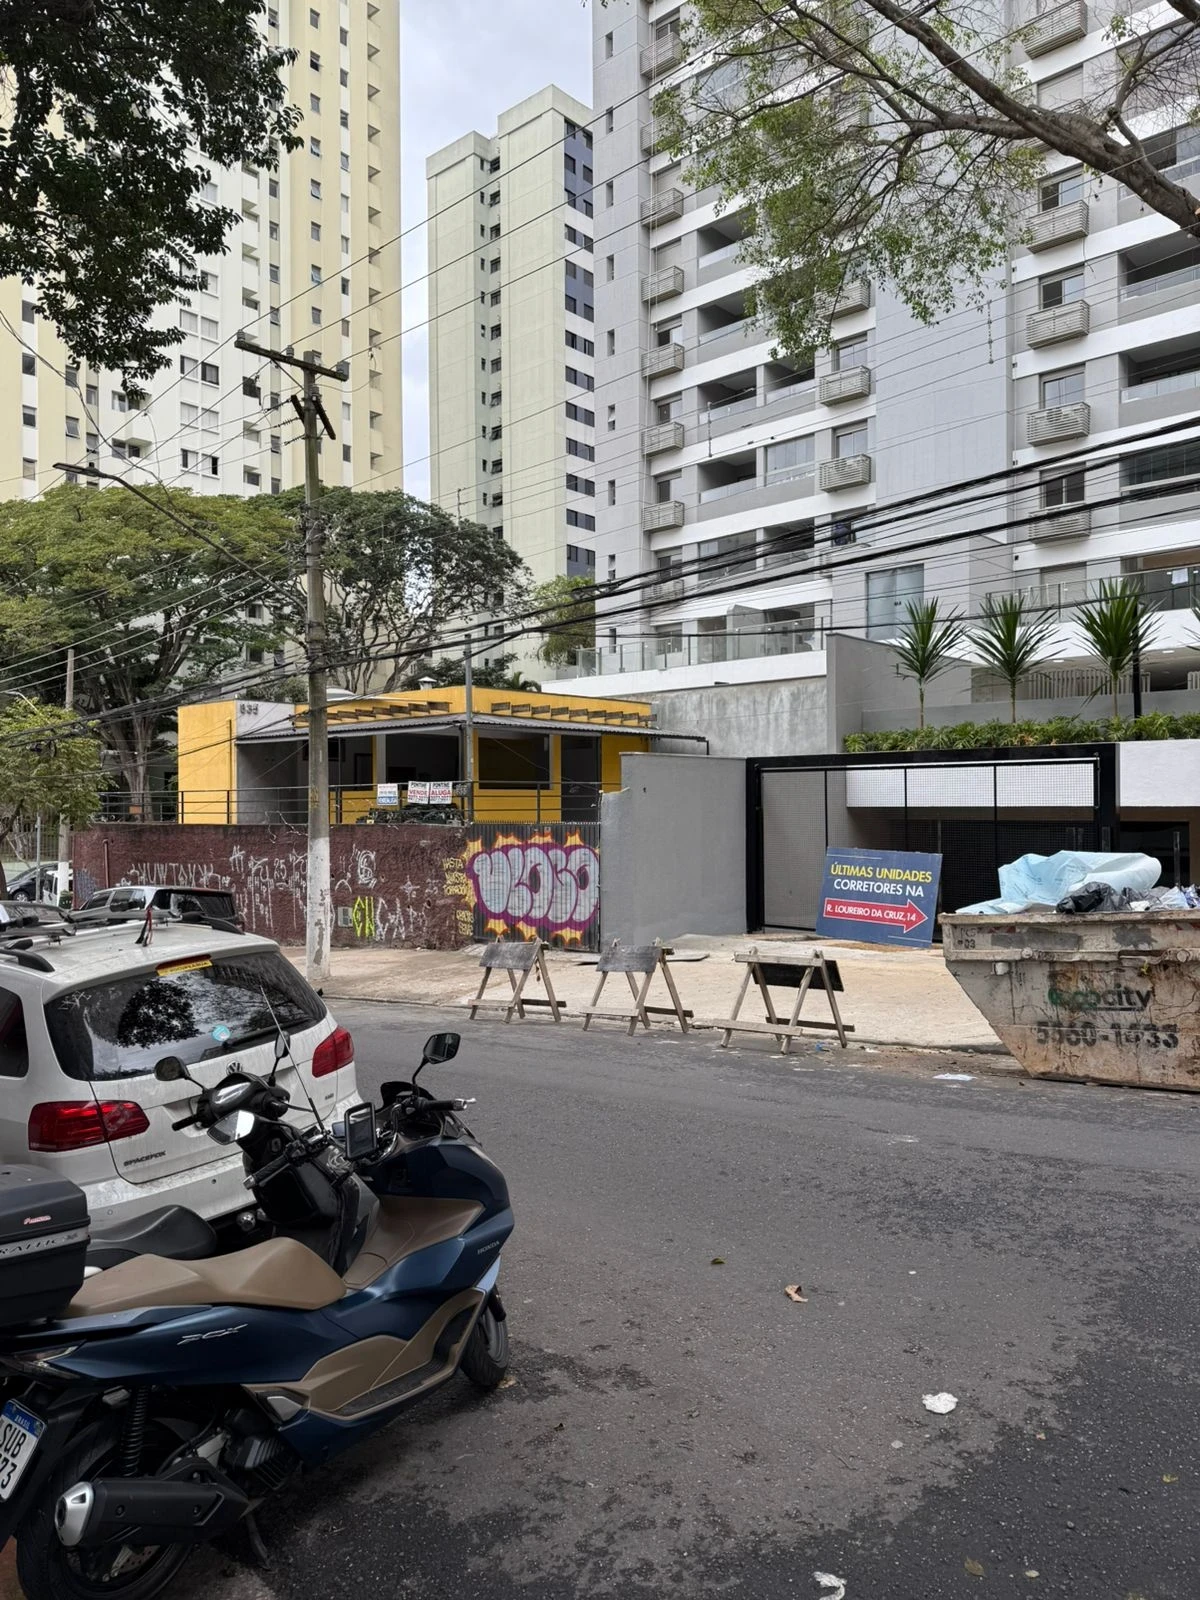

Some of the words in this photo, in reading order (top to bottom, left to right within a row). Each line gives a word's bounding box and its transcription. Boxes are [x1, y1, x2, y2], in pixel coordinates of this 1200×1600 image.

[830, 861, 873, 878] ÚLTIMAS
[875, 867, 932, 883] UNIDADES
[833, 878, 903, 896] CORRETORES
[905, 884, 924, 898] NA
[826, 904, 834, 912] R.
[834, 905, 870, 917] LOUREIRO
[477, 1240, 500, 1255] HONDA
